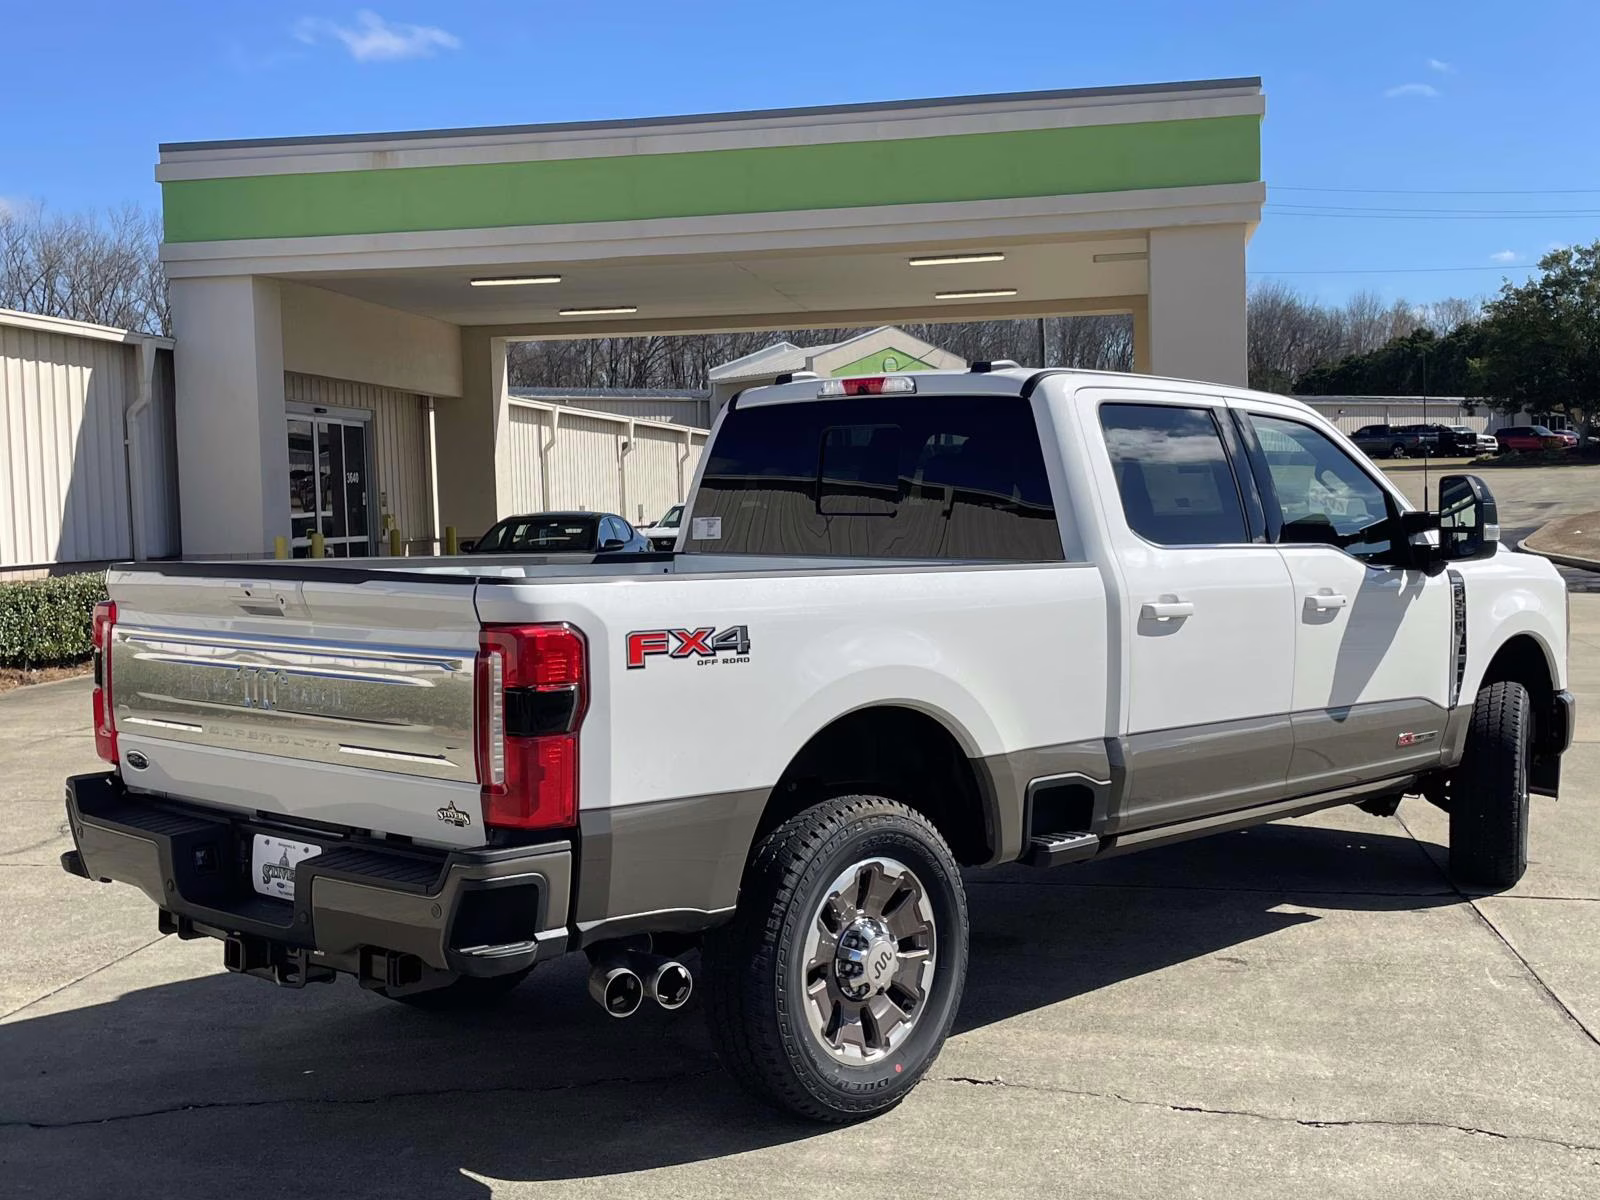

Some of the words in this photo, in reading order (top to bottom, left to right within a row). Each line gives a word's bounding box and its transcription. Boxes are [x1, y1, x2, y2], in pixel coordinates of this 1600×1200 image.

[626, 625, 751, 670] FX4
[697, 658, 718, 666] OFF
[437, 807, 471, 826] STIVERS
[262, 864, 295, 884] STIVE
